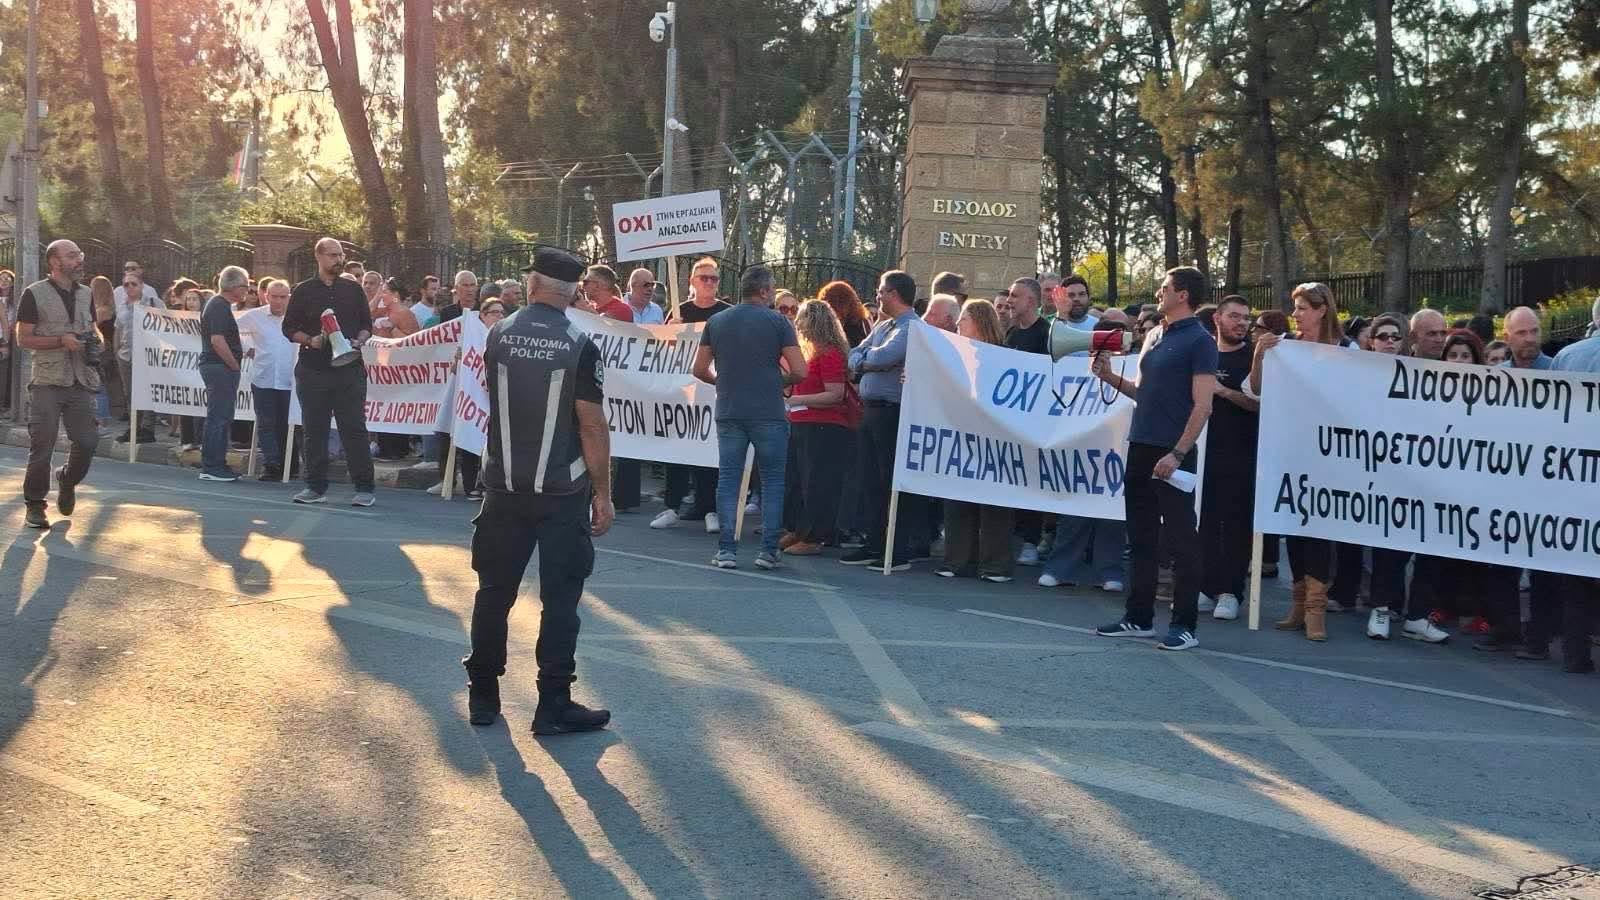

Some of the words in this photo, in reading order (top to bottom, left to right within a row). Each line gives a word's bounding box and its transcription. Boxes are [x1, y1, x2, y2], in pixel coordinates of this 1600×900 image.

[656, 212, 676, 221] ΣΤΗΝ
[676, 206, 716, 218] ΕΡΓΑΣΙΑΚΗ
[932, 199, 1017, 218] ΕΙΣΟΔΟΣ
[618, 214, 653, 234] ΟΧΙ
[658, 220, 717, 237] ΑΝΑΣΦΑΛΕΙΑ
[938, 231, 1008, 250] ENTRY
[499, 334, 571, 352] ΑΣΤΥΝΟΜΙΑ
[510, 347, 555, 361] POLICE
[433, 362, 451, 384] ΣΤ
[992, 368, 1047, 413] ΟΧΙ
[1388, 359, 1572, 424] Διασφάλιση
[1581, 381, 1600, 413] τ
[384, 402, 441, 424] ΔΙΟΡΙΣΙΜ
[608, 397, 646, 436] ΣΤΟΝ
[654, 402, 713, 442] ΔΡΟΜΟ
[906, 424, 1028, 487] ΕΡΓΑΣΙΑΚΗ
[1038, 447, 1126, 498] ΑΝΑΣΦ
[1318, 424, 1533, 477] υπηρετούντων
[1273, 472, 1425, 543] Αξιοποίηση
[1434, 502, 1480, 551] της
